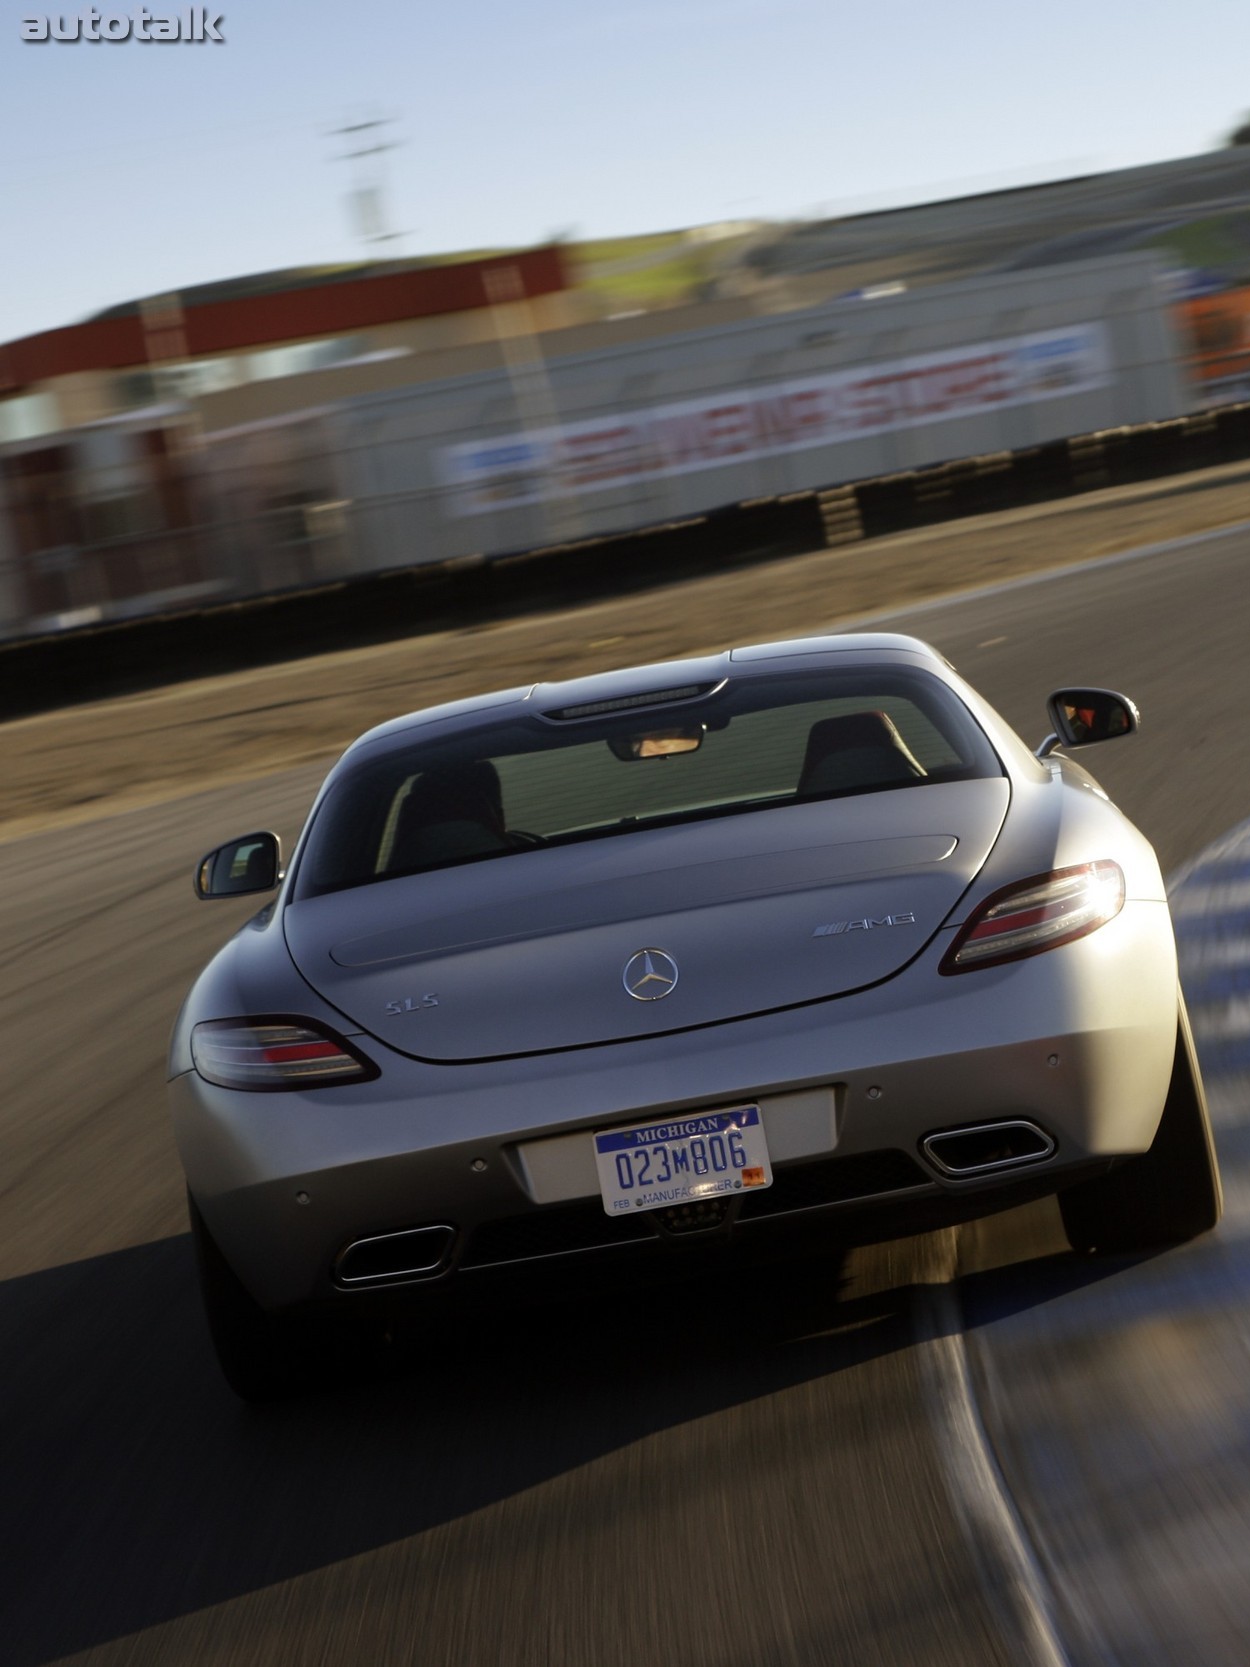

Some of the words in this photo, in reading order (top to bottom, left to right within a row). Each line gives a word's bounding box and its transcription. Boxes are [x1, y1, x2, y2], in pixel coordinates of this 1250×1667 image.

[849, 913, 915, 930] AMG
[385, 993, 440, 1016] SLS
[636, 1117, 718, 1143] MICHIGAN
[615, 1132, 747, 1189] 023M806
[613, 1199, 630, 1210] FEB
